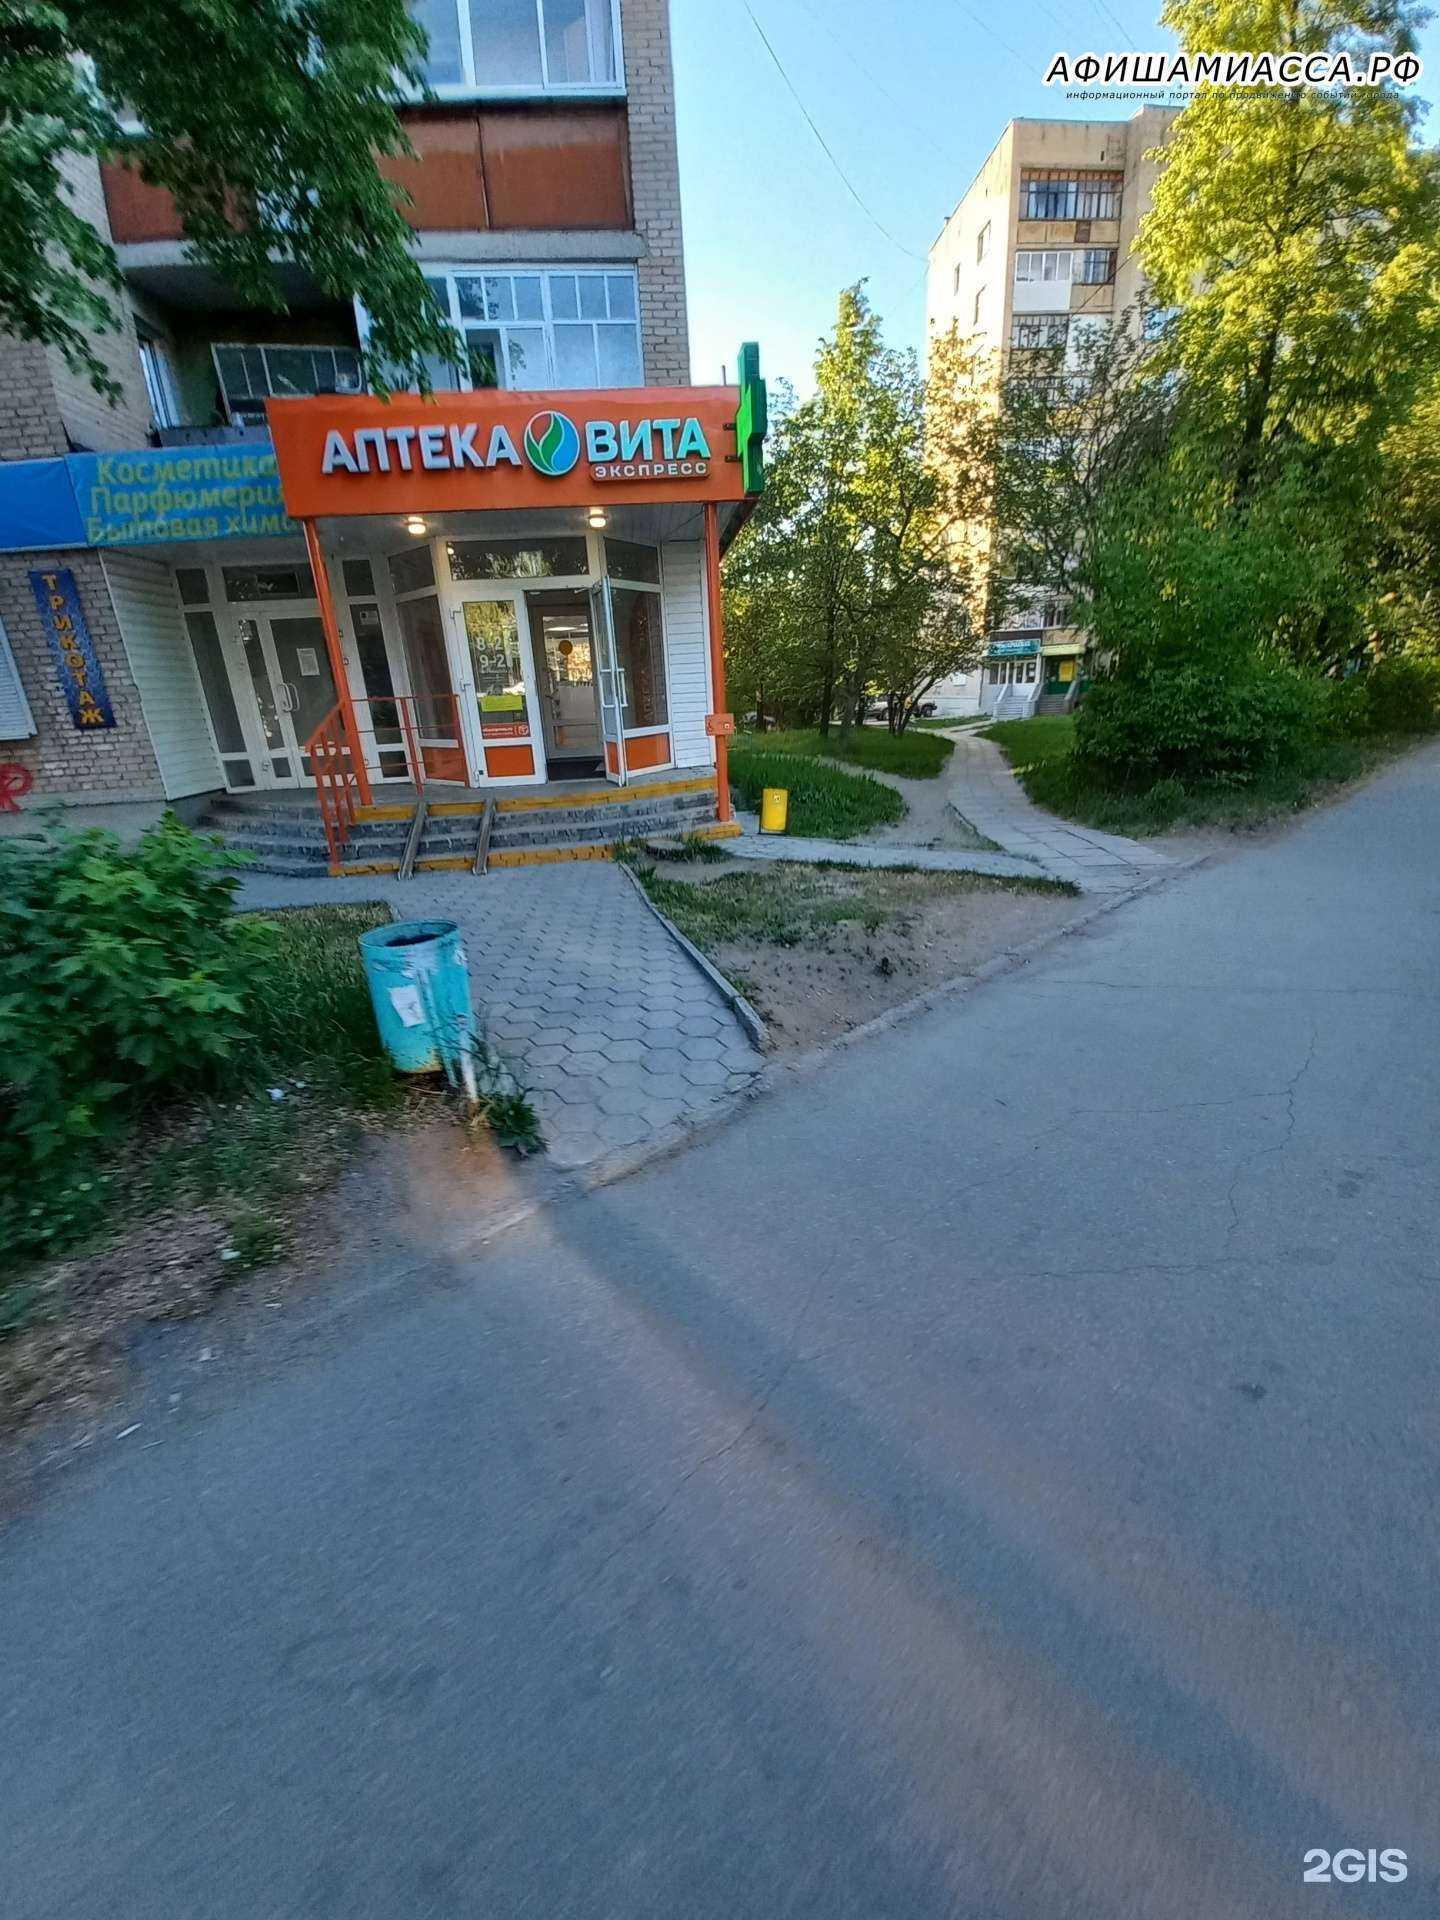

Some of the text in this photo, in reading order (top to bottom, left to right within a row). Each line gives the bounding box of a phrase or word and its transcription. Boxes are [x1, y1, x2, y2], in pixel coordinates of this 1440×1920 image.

[321, 416, 711, 475] АПТЕКА ВИТА
[593, 460, 709, 479] ЭКСПРЕСС
[88, 516, 219, 542] Бытовая
[41, 573, 105, 727] ТРИКОТАЖ
